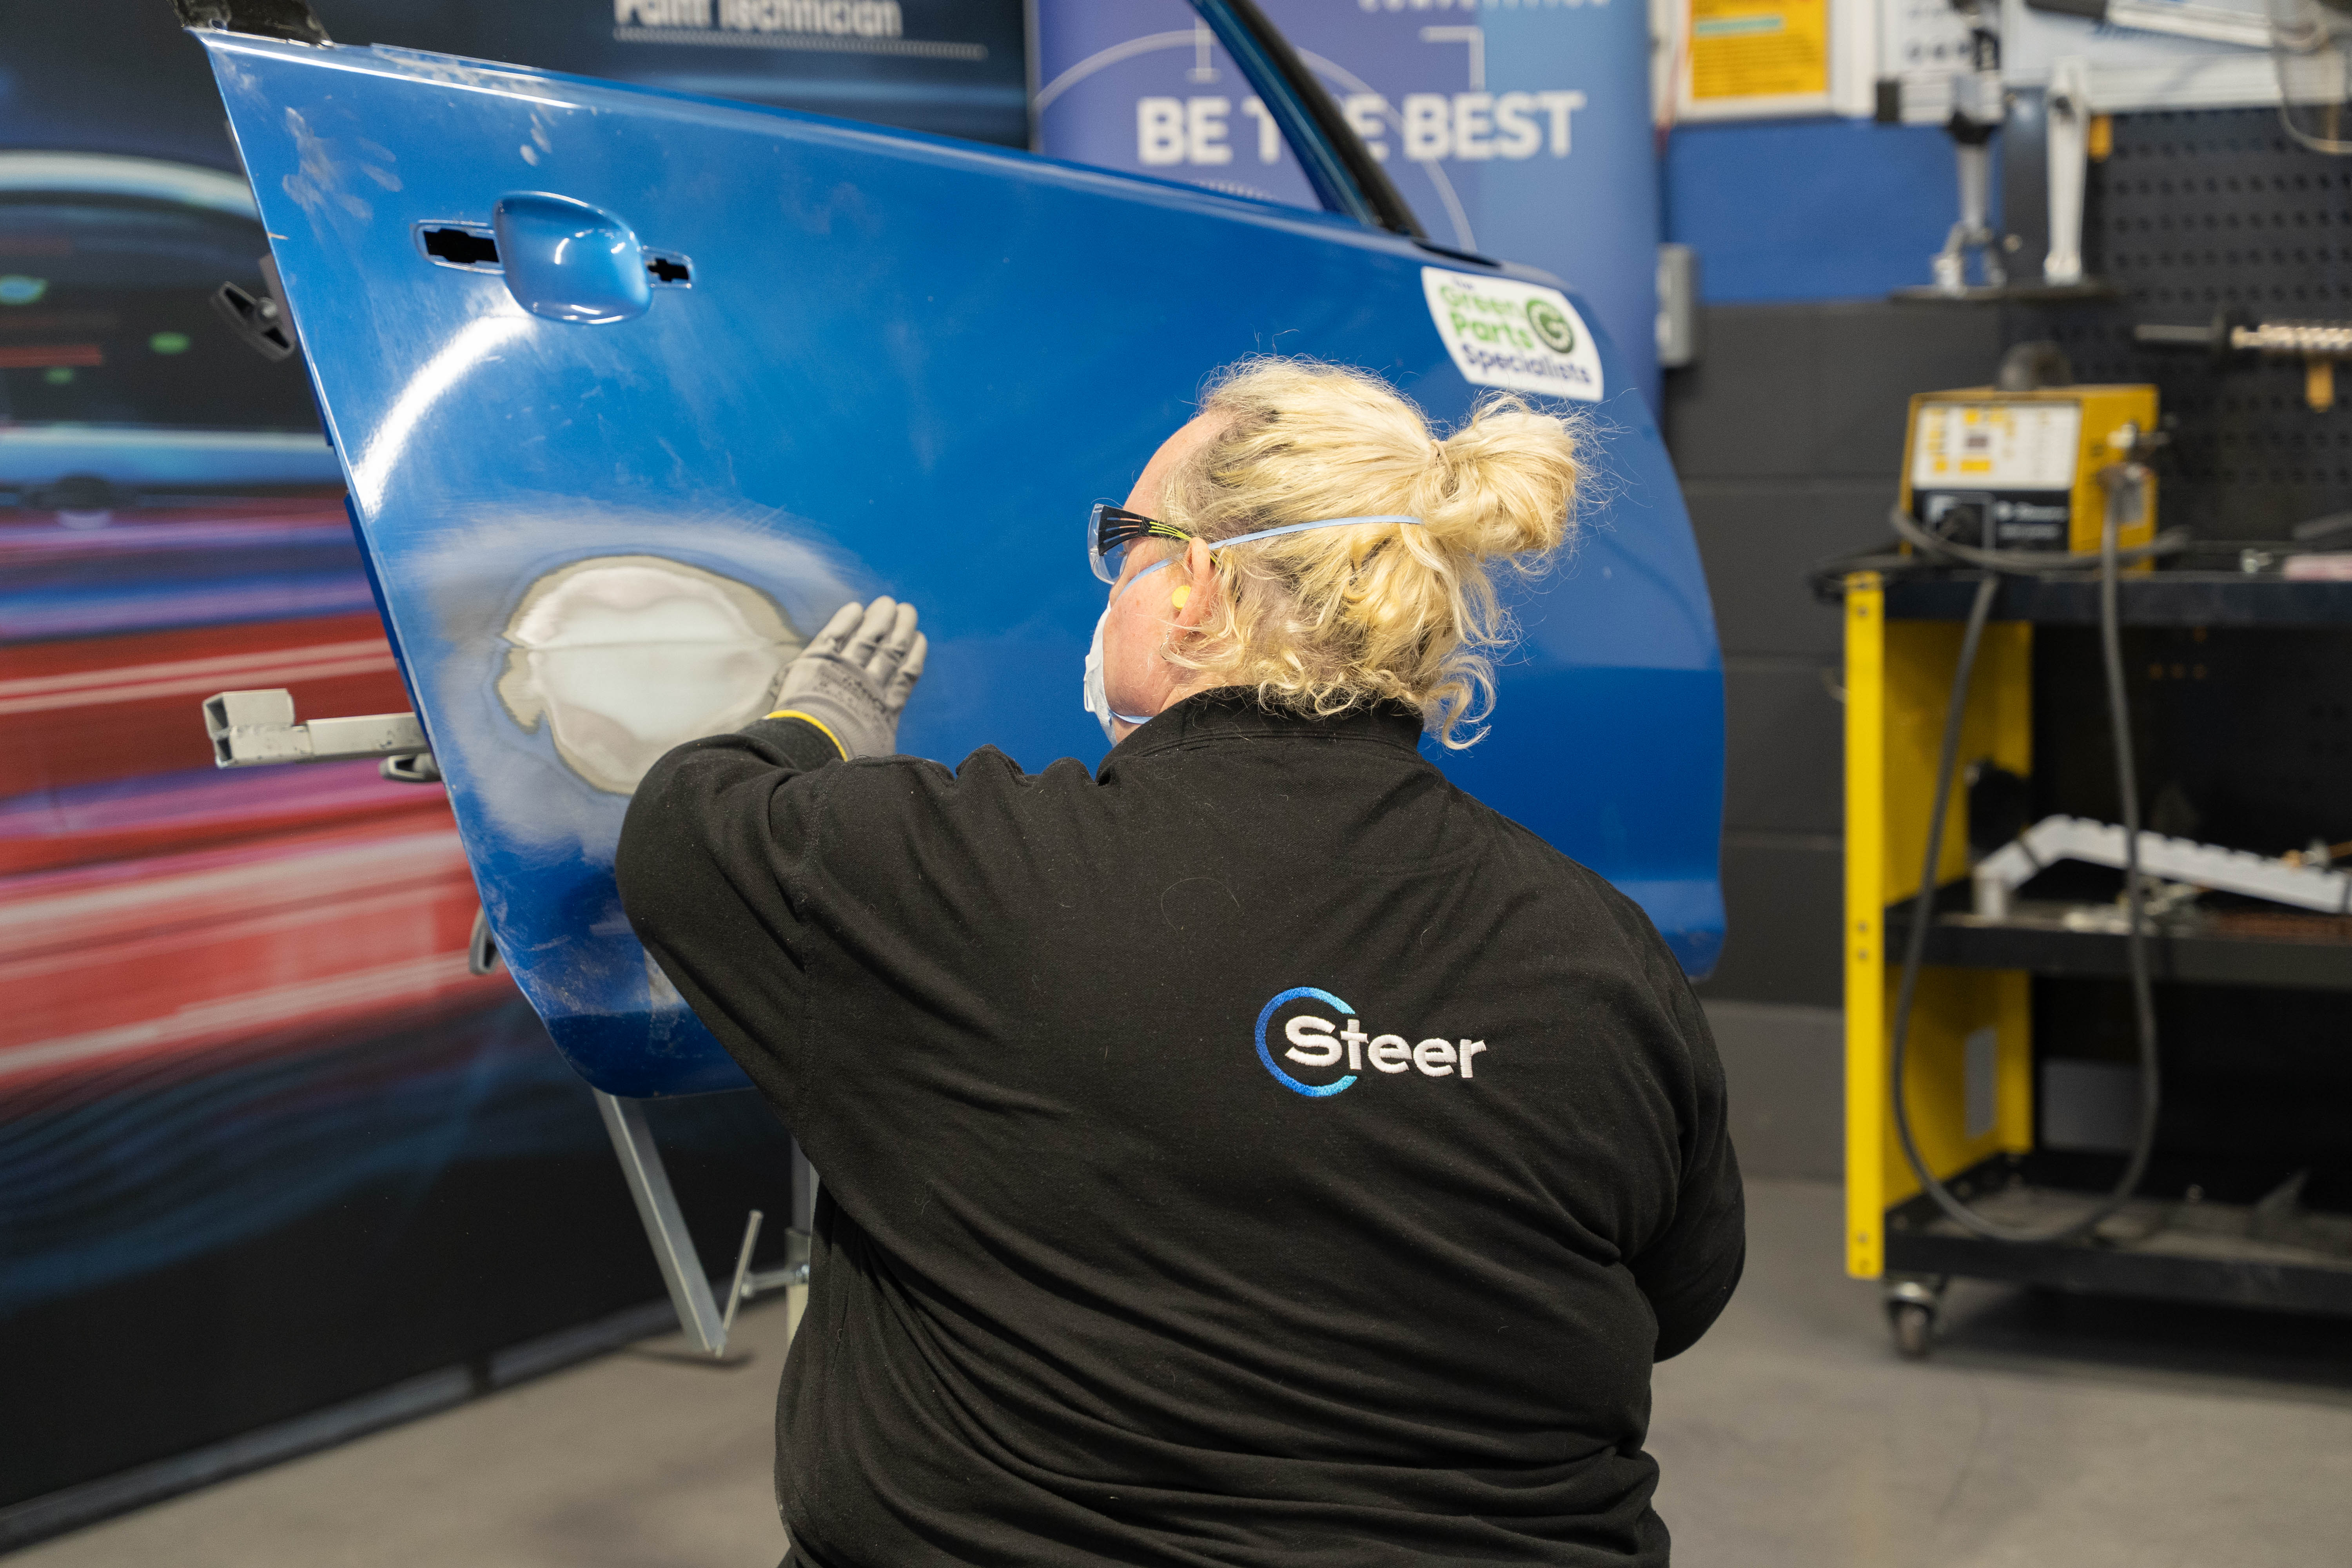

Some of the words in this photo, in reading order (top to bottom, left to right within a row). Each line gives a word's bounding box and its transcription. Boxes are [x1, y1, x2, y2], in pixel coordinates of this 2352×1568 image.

[1138, 96, 1233, 165] BE
[1241, 96, 1390, 165] TE
[1403, 91, 1586, 160] BEST
[1440, 285, 1525, 318] Green
[1450, 311, 1534, 349] Parts
[1461, 343, 1591, 383] Specialists
[1285, 1015, 1487, 1078] Steer
